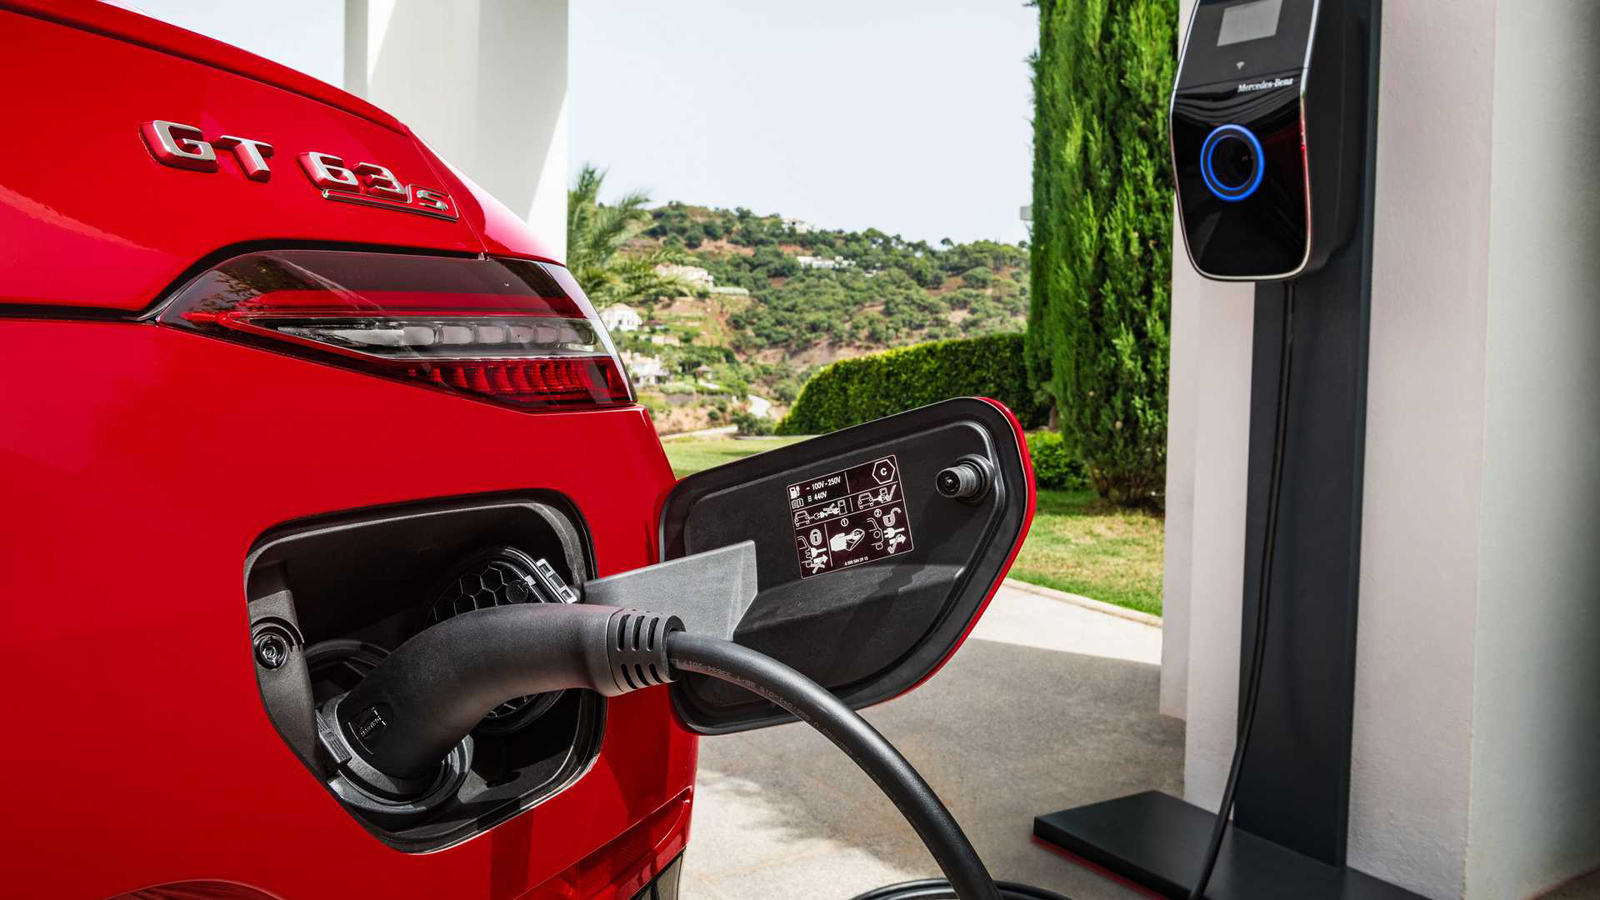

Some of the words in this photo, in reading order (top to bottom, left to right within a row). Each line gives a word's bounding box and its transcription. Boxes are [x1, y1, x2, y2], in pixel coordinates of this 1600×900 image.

[1238, 78, 1294, 93] Mercedes-Benz
[138, 119, 274, 183] GT
[880, 467, 888, 476] C
